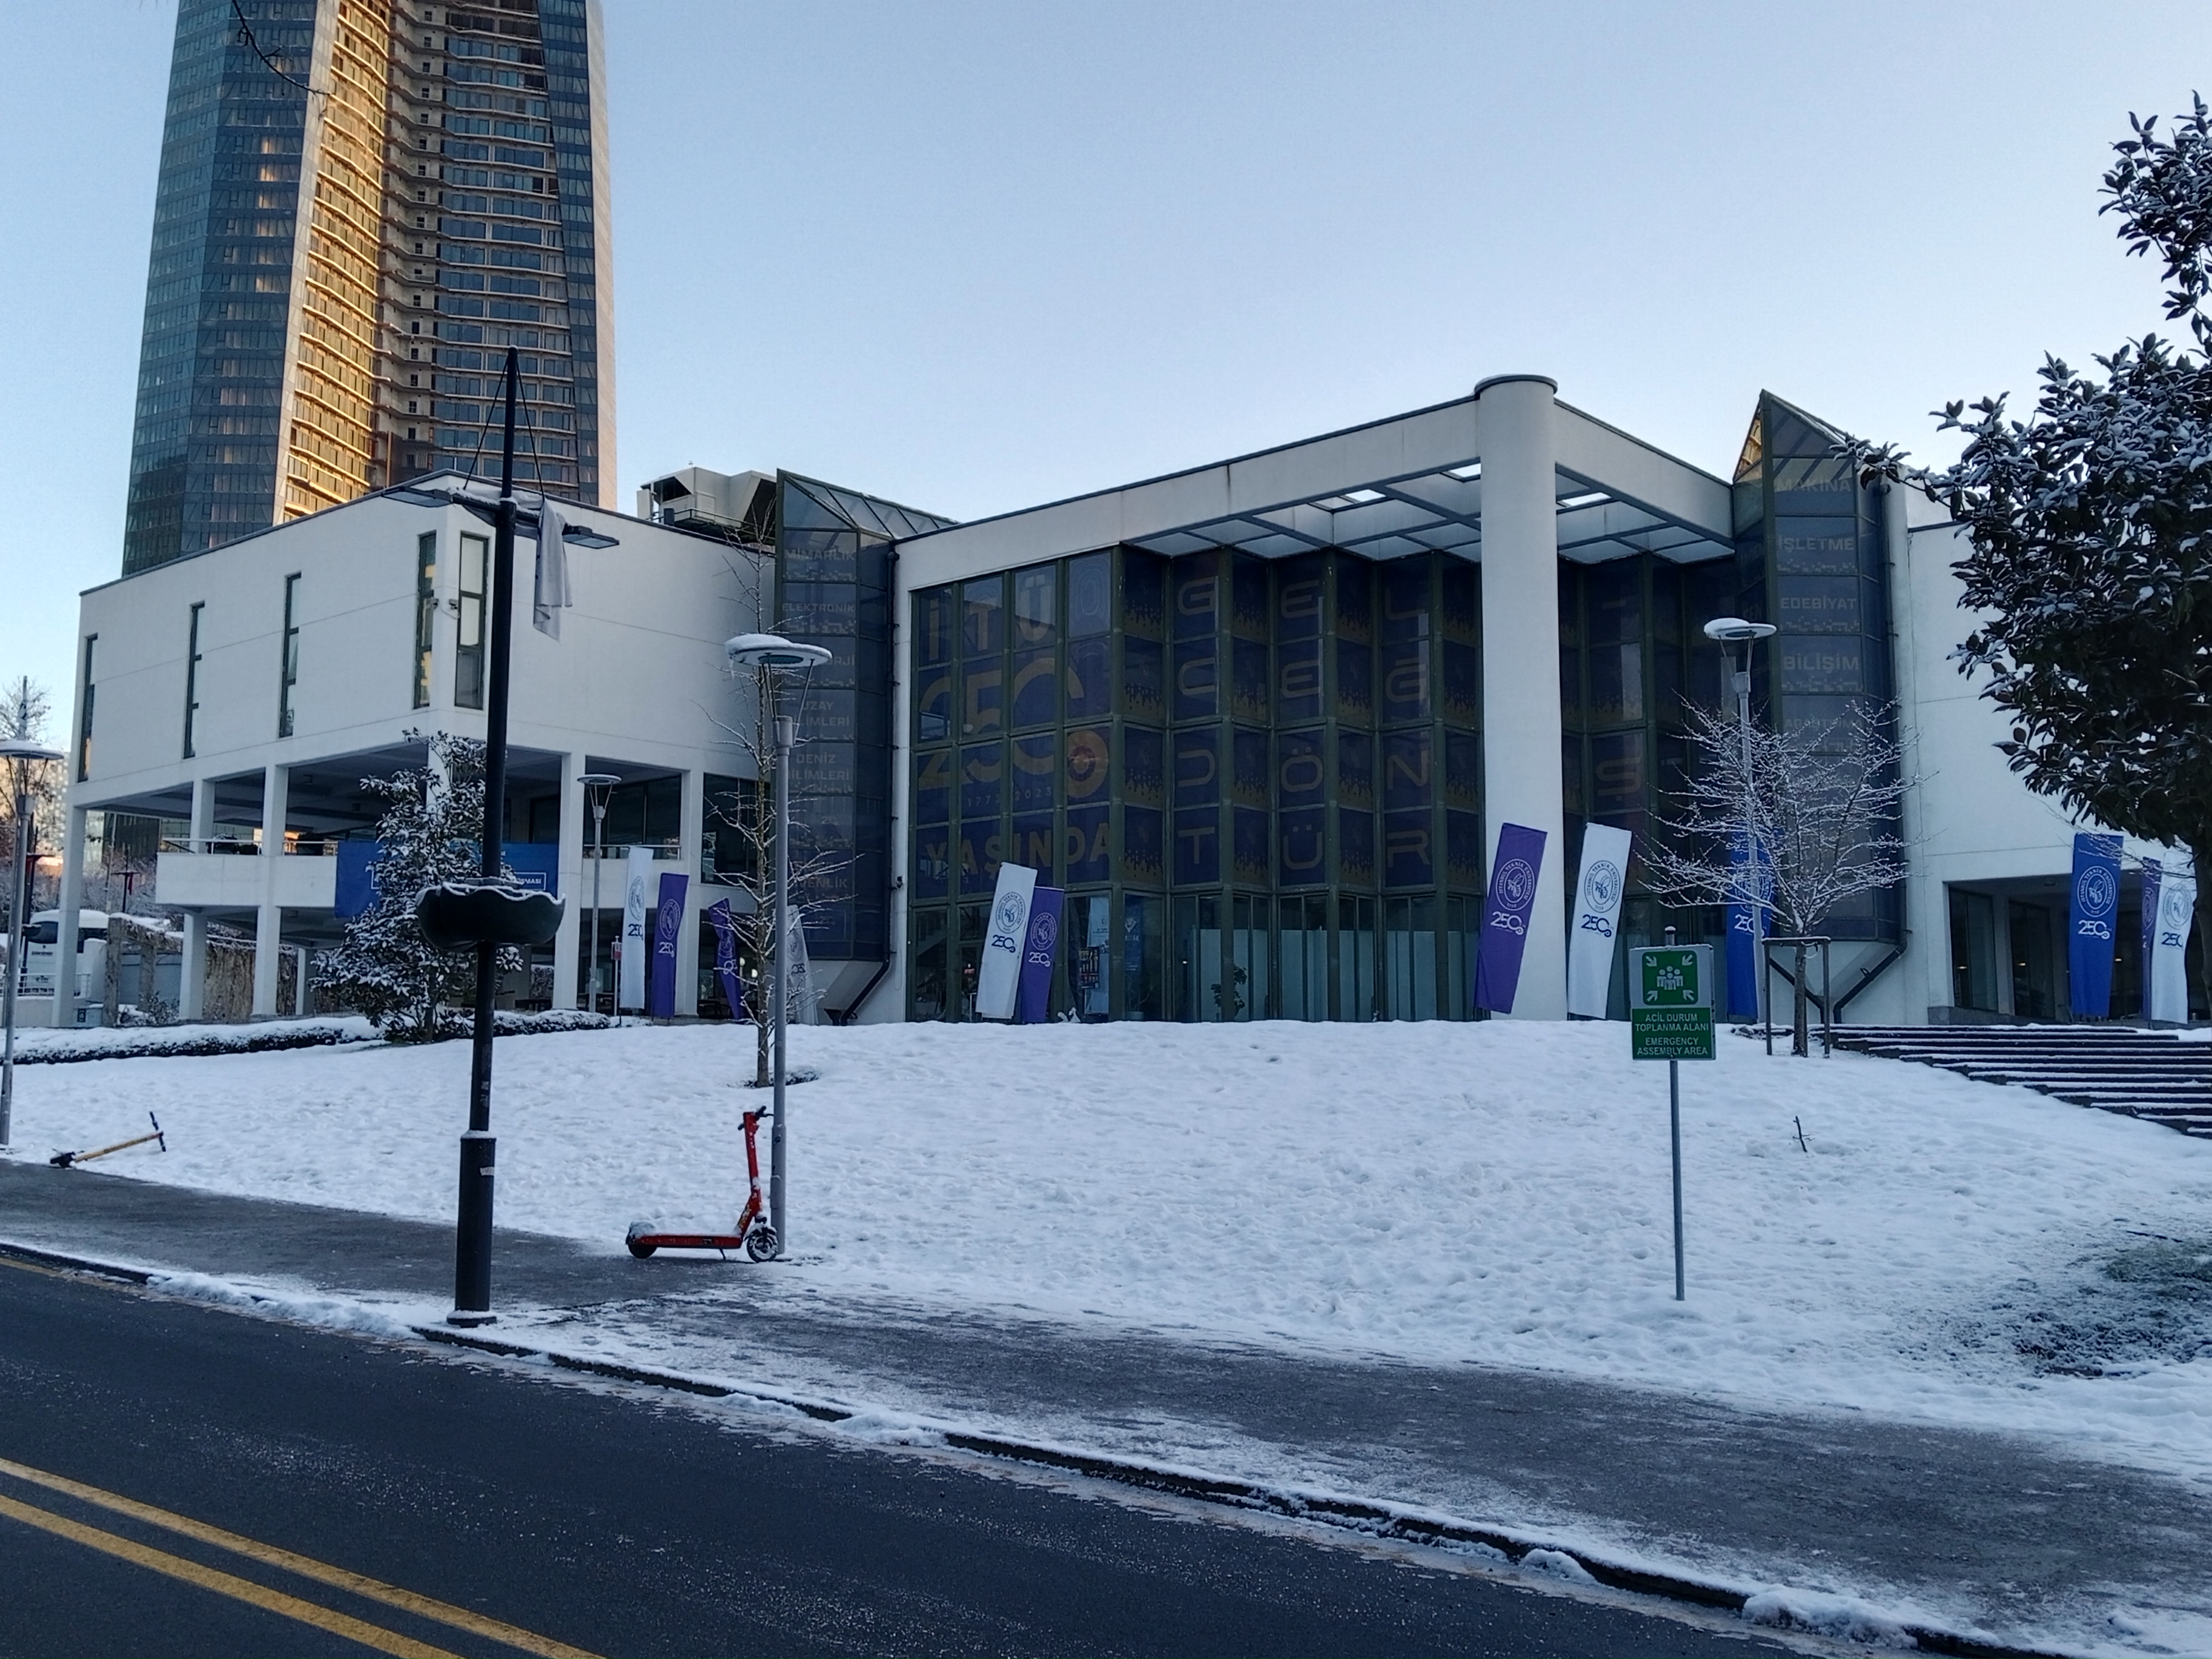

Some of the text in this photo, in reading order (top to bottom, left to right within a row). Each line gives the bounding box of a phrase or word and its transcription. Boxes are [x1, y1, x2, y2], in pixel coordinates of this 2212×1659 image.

[1778, 534, 1855, 553] İŞLETME
[782, 602, 855, 613] ELEKTRONİK
[1780, 596, 1857, 610] EDEBİYAT
[1784, 653, 1859, 674] BİLİŞİM
[796, 752, 837, 764] DENİZ
[1014, 786, 1052, 801] 2023
[1645, 1012, 1697, 1021] ACİL DURUM
[1636, 1024, 1682, 1032] TOPLANMA
[1645, 1037, 1699, 1045] EMERGENCY
[1637, 1047, 1682, 1055] ASSEMBLY
